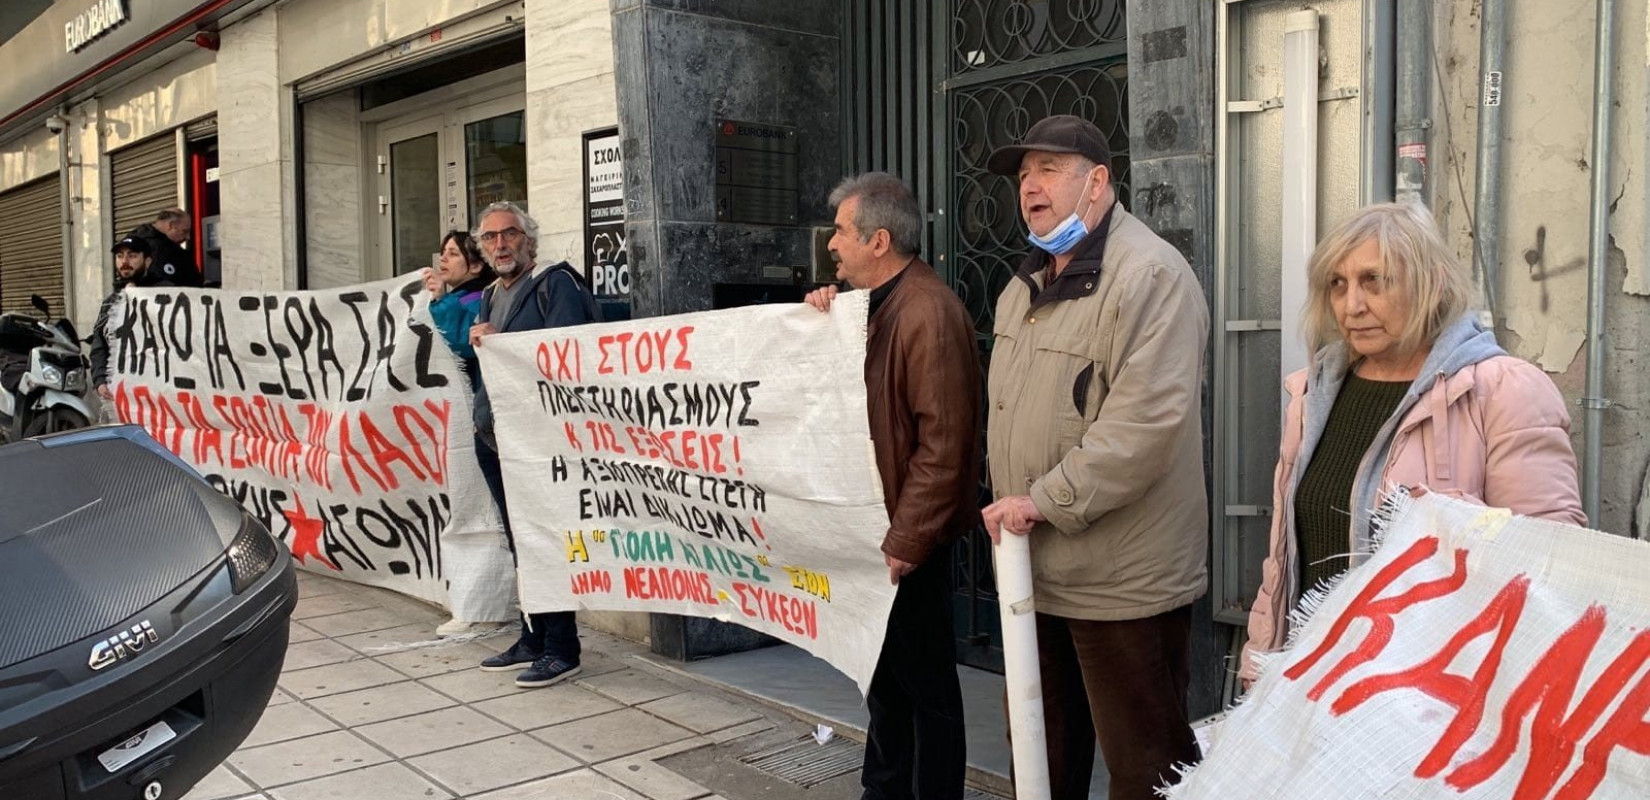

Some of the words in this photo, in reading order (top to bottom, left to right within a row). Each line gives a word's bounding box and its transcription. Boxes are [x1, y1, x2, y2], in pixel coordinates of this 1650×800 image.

[65, 0, 124, 53] EUROBANK
[738, 126, 787, 140] EUROBANK
[718, 160, 727, 175] 5
[115, 292, 197, 390] ΚΑΤΩ
[201, 295, 246, 392] ΤΑ
[239, 295, 345, 402] ΞΕΡΑ
[339, 279, 449, 402] ΣΑΣ
[536, 338, 581, 382] ΟΧΙ
[597, 326, 695, 376] ΣΤΟΥΣ
[177, 391, 223, 467] ΤΑ
[339, 398, 451, 496] ΛΑΟΥ
[564, 420, 583, 453] Κ
[586, 420, 626, 454] ΤΙΣ
[551, 454, 568, 484] Η
[580, 488, 637, 521] ΕΙΝΑΙ
[564, 529, 589, 563] Η
[570, 569, 612, 595] ΔΗΜΟ
[623, 566, 720, 605] ΝΕΑΠΟΛΗΣ
[732, 582, 818, 640] ΣΥΚΕΩΝ
[88, 619, 159, 670] GIVI
